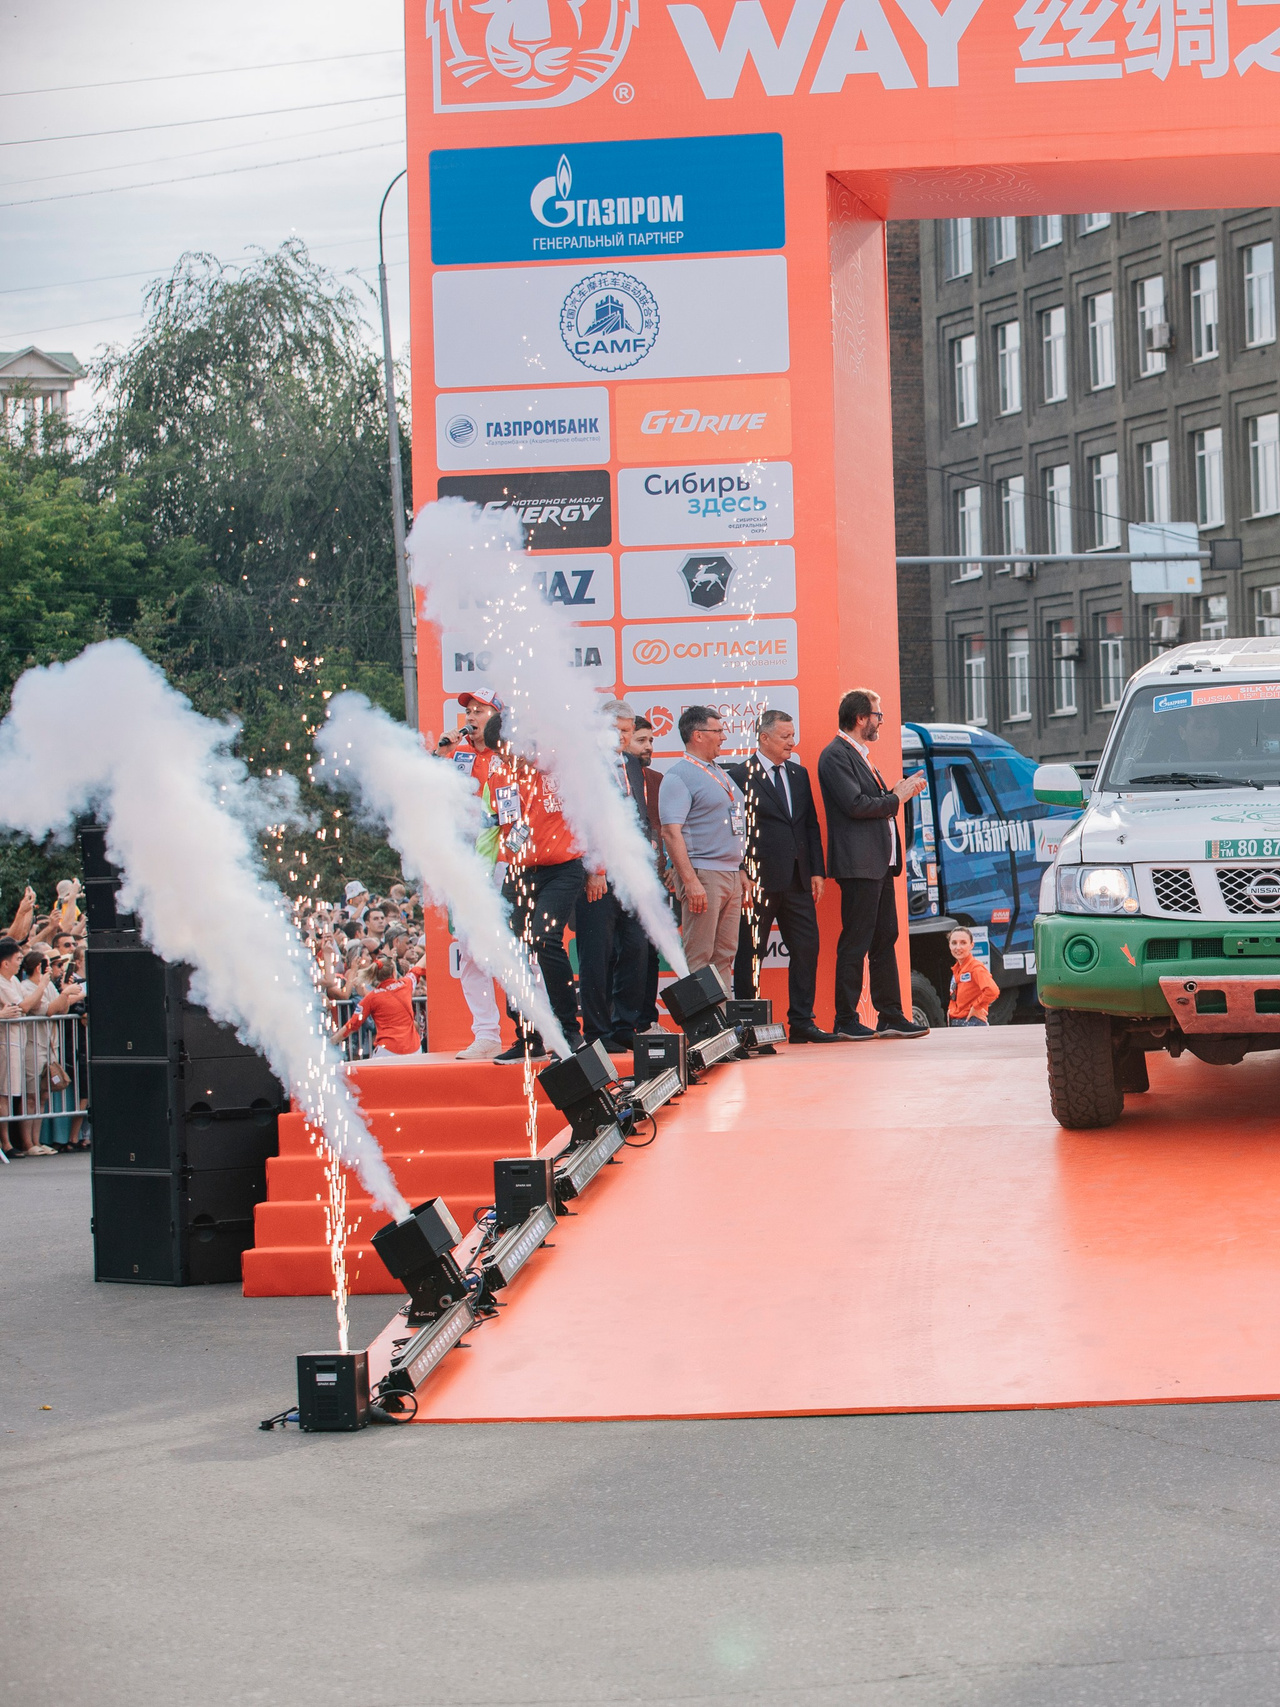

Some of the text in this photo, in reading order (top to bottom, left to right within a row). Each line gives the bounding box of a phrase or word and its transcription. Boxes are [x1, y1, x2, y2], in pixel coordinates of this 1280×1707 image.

[666, 0, 983, 100] WAY
[576, 194, 684, 227] ГАЗПРОМ
[533, 230, 684, 250] ГЕНЕРАЛЬНЫЙ ПАРТНЕР
[574, 338, 646, 355] CAMF
[486, 417, 600, 438] ГАЗПРОМБАНК
[644, 471, 751, 498] Сибирь
[511, 498, 567, 506] МОТОРНОЕ
[688, 496, 768, 518] здесь
[673, 639, 787, 659] СОГЛАСИЕ
[1196, 694, 1233, 704] RUSSIA
[966, 819, 1031, 854] ГАЗПРОМ
[1220, 848, 1234, 857] TM
[1237, 840, 1258, 857] 80
